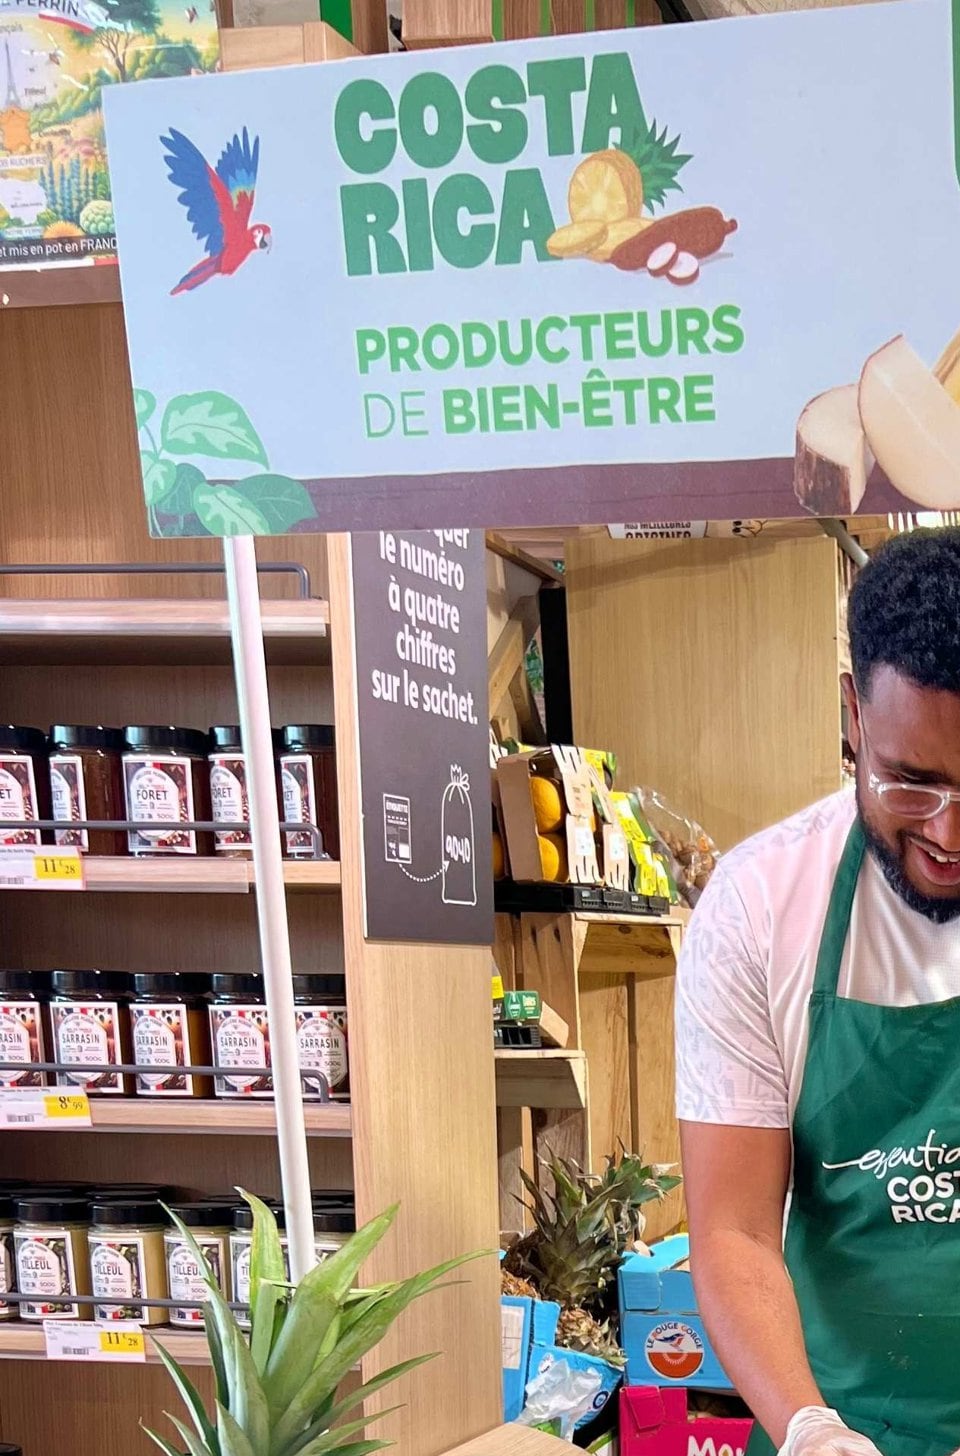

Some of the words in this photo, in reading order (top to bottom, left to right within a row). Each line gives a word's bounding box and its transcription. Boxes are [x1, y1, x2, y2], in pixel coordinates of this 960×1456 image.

[334, 52, 650, 175] COSTA
[340, 168, 563, 277] RICA
[9, 245, 29, 257] mis
[30, 245, 43, 256] en
[45, 243, 63, 256] pot
[65, 241, 78, 252] en
[356, 304, 745, 375] PRODUCTEURS
[363, 390, 429, 438] DE
[442, 368, 717, 435] BIEN-ÊTRE
[428, 528, 470, 549] quer
[380, 530, 397, 564] le
[400, 541, 465, 592] numéro
[389, 575, 401, 612] à
[404, 587, 461, 634] quatre
[396, 622, 456, 677] chiffres
[372, 668, 400, 704] sur
[403, 669, 419, 708] le
[422, 681, 479, 726] sachet.
[446, 834, 471, 864] 9040
[62, 1033, 100, 1044] SARRASIN
[220, 1036, 258, 1048] SARRASIN
[300, 1038, 340, 1049] SARRASIN
[21, 1260, 52, 1270] TILLEUL
[94, 1264, 123, 1276] TILLEUL
[172, 1265, 202, 1276] TILLEU
[647, 1338, 654, 1348] LE
[652, 1322, 678, 1340] ROUGE
[681, 1325, 702, 1349] GORGE
